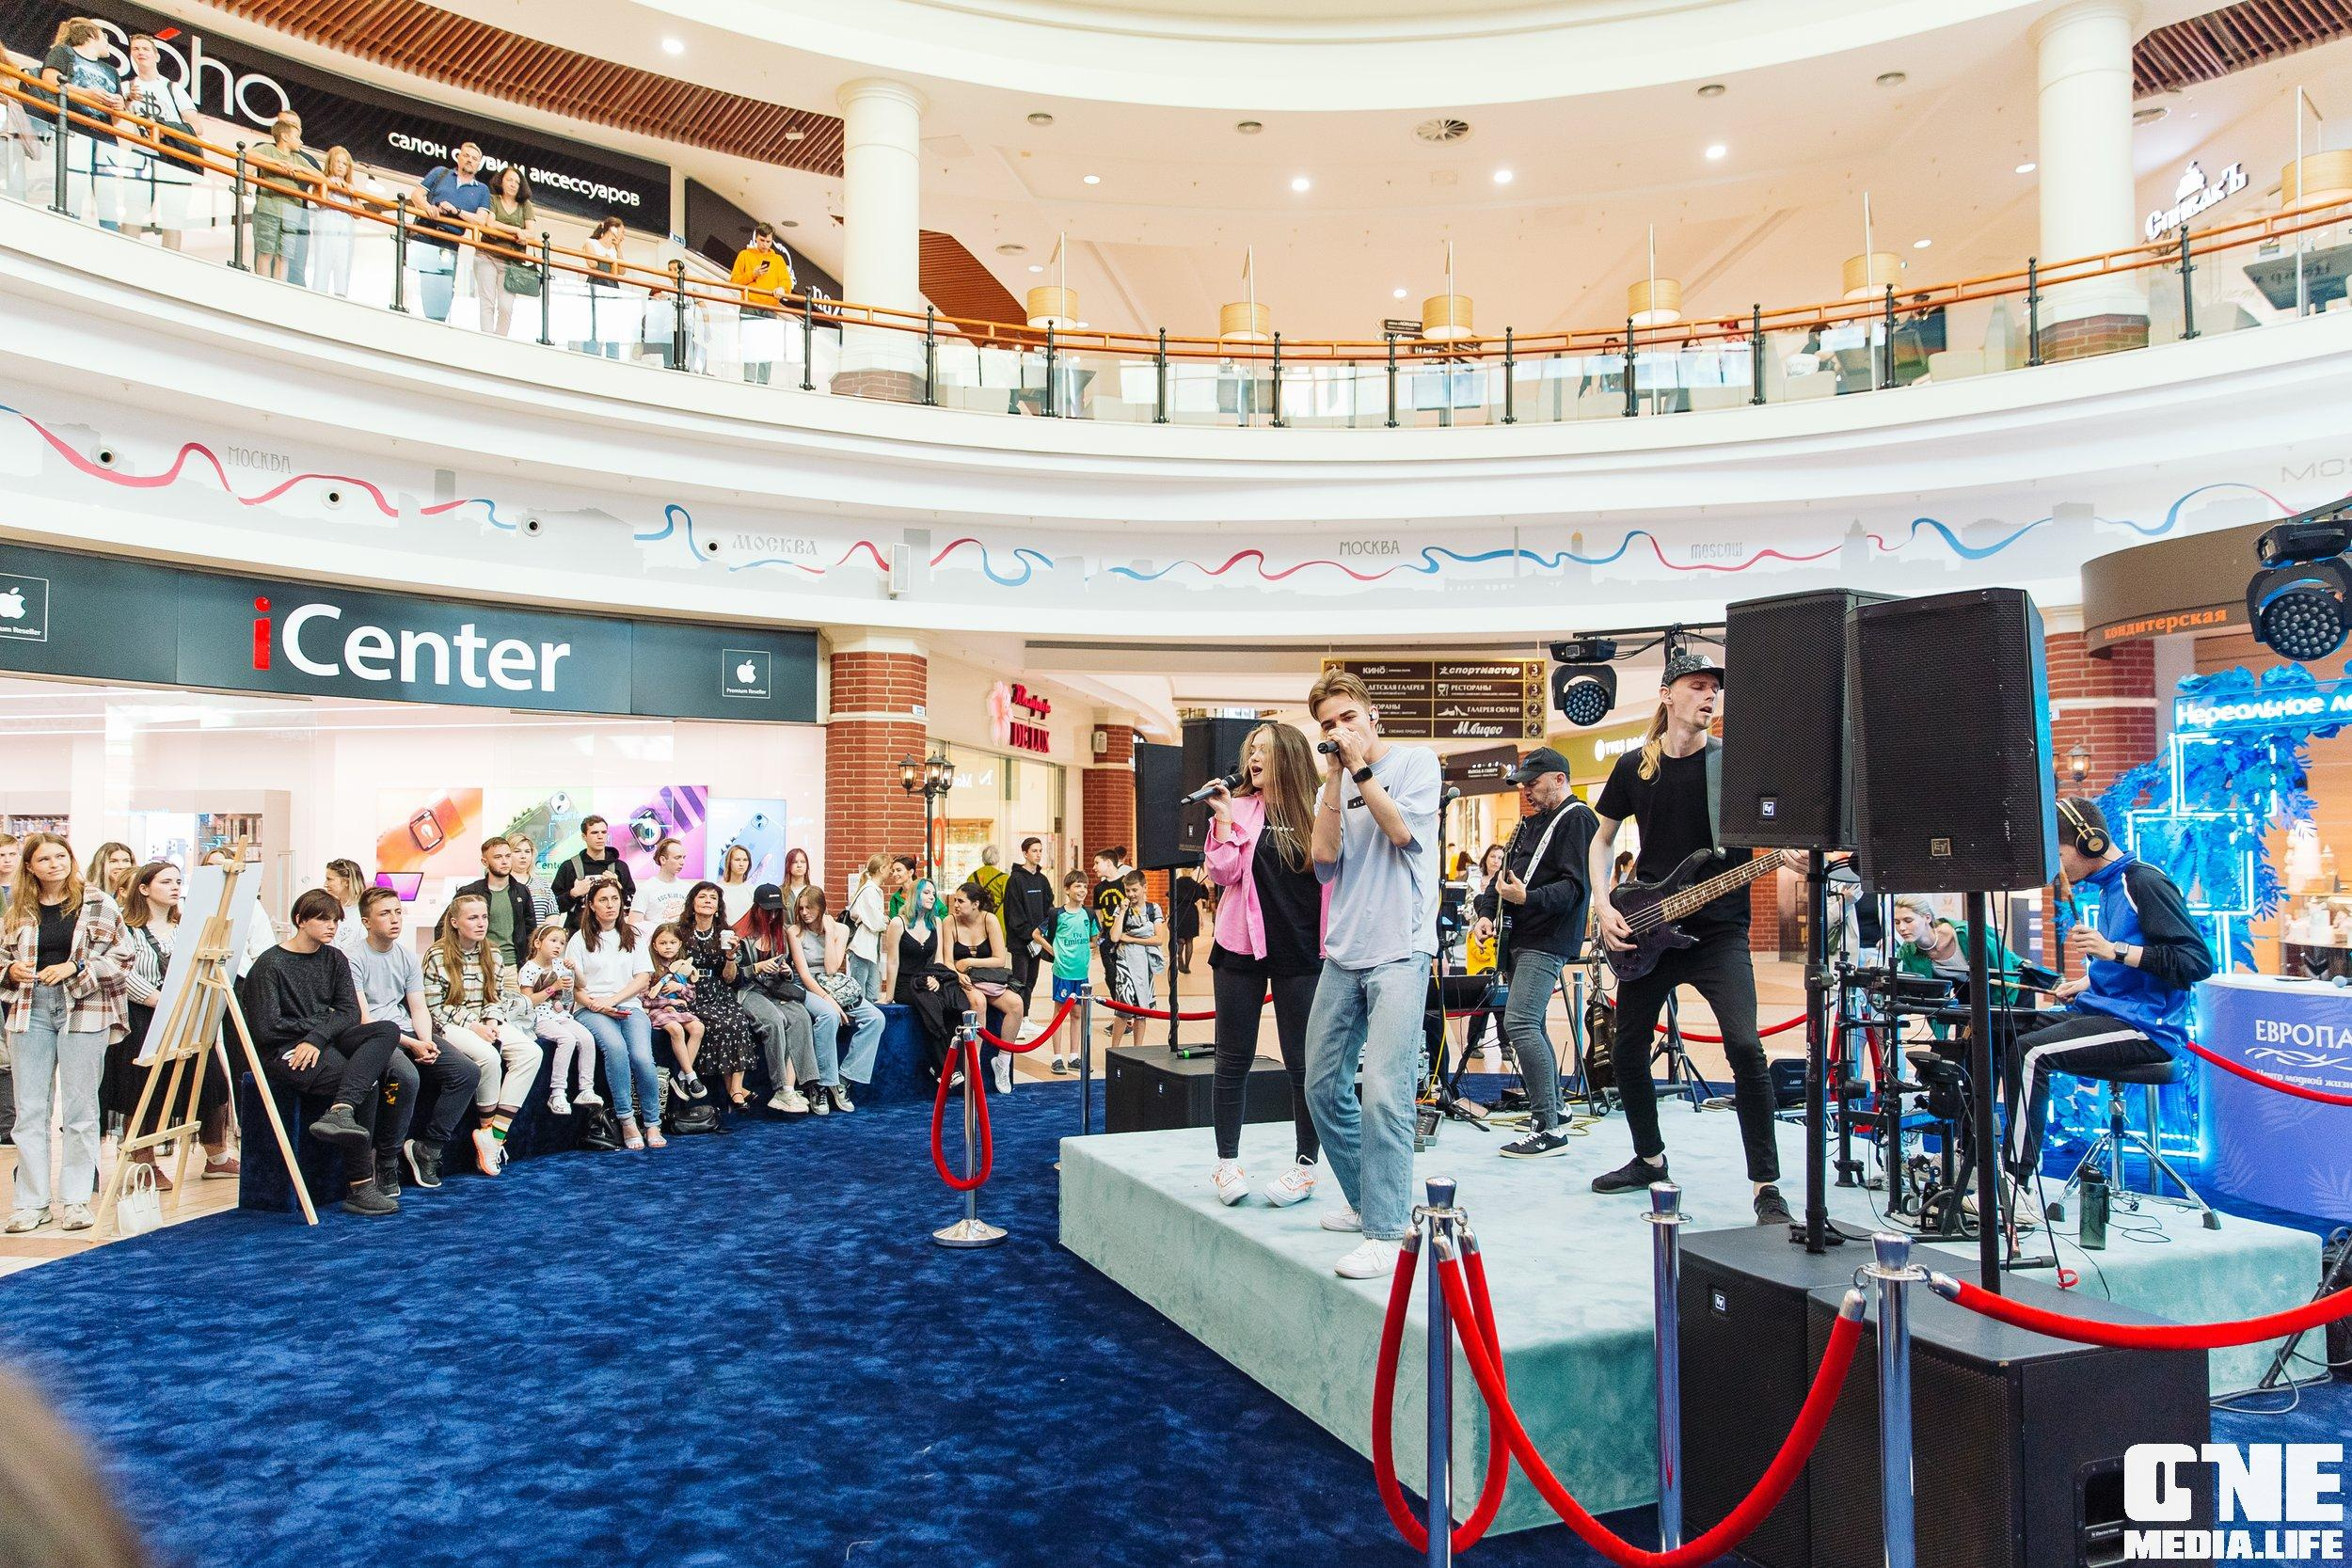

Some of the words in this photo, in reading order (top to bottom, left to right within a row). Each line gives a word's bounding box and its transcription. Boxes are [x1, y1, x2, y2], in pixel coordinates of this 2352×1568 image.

[388, 132, 447, 160] салон
[529, 166, 641, 207] аксессуаров
[228, 446, 292, 474] МОСКВА
[2281, 458, 2352, 483] MO
[732, 533, 819, 556] МОСКВА
[1339, 540, 1401, 556] МОСКВА
[2104, 609, 2228, 641] кондитерская
[252, 595, 571, 693] iCenter
[1531, 663, 1539, 674] 3
[1531, 684, 1539, 693] 3
[1531, 704, 1539, 714] 2
[2177, 696, 2325, 728] Нереальное
[1453, 721, 1503, 737] М.видео
[1531, 722, 1539, 733] 2
[2255, 1020, 2352, 1049] ЕВРОПА
